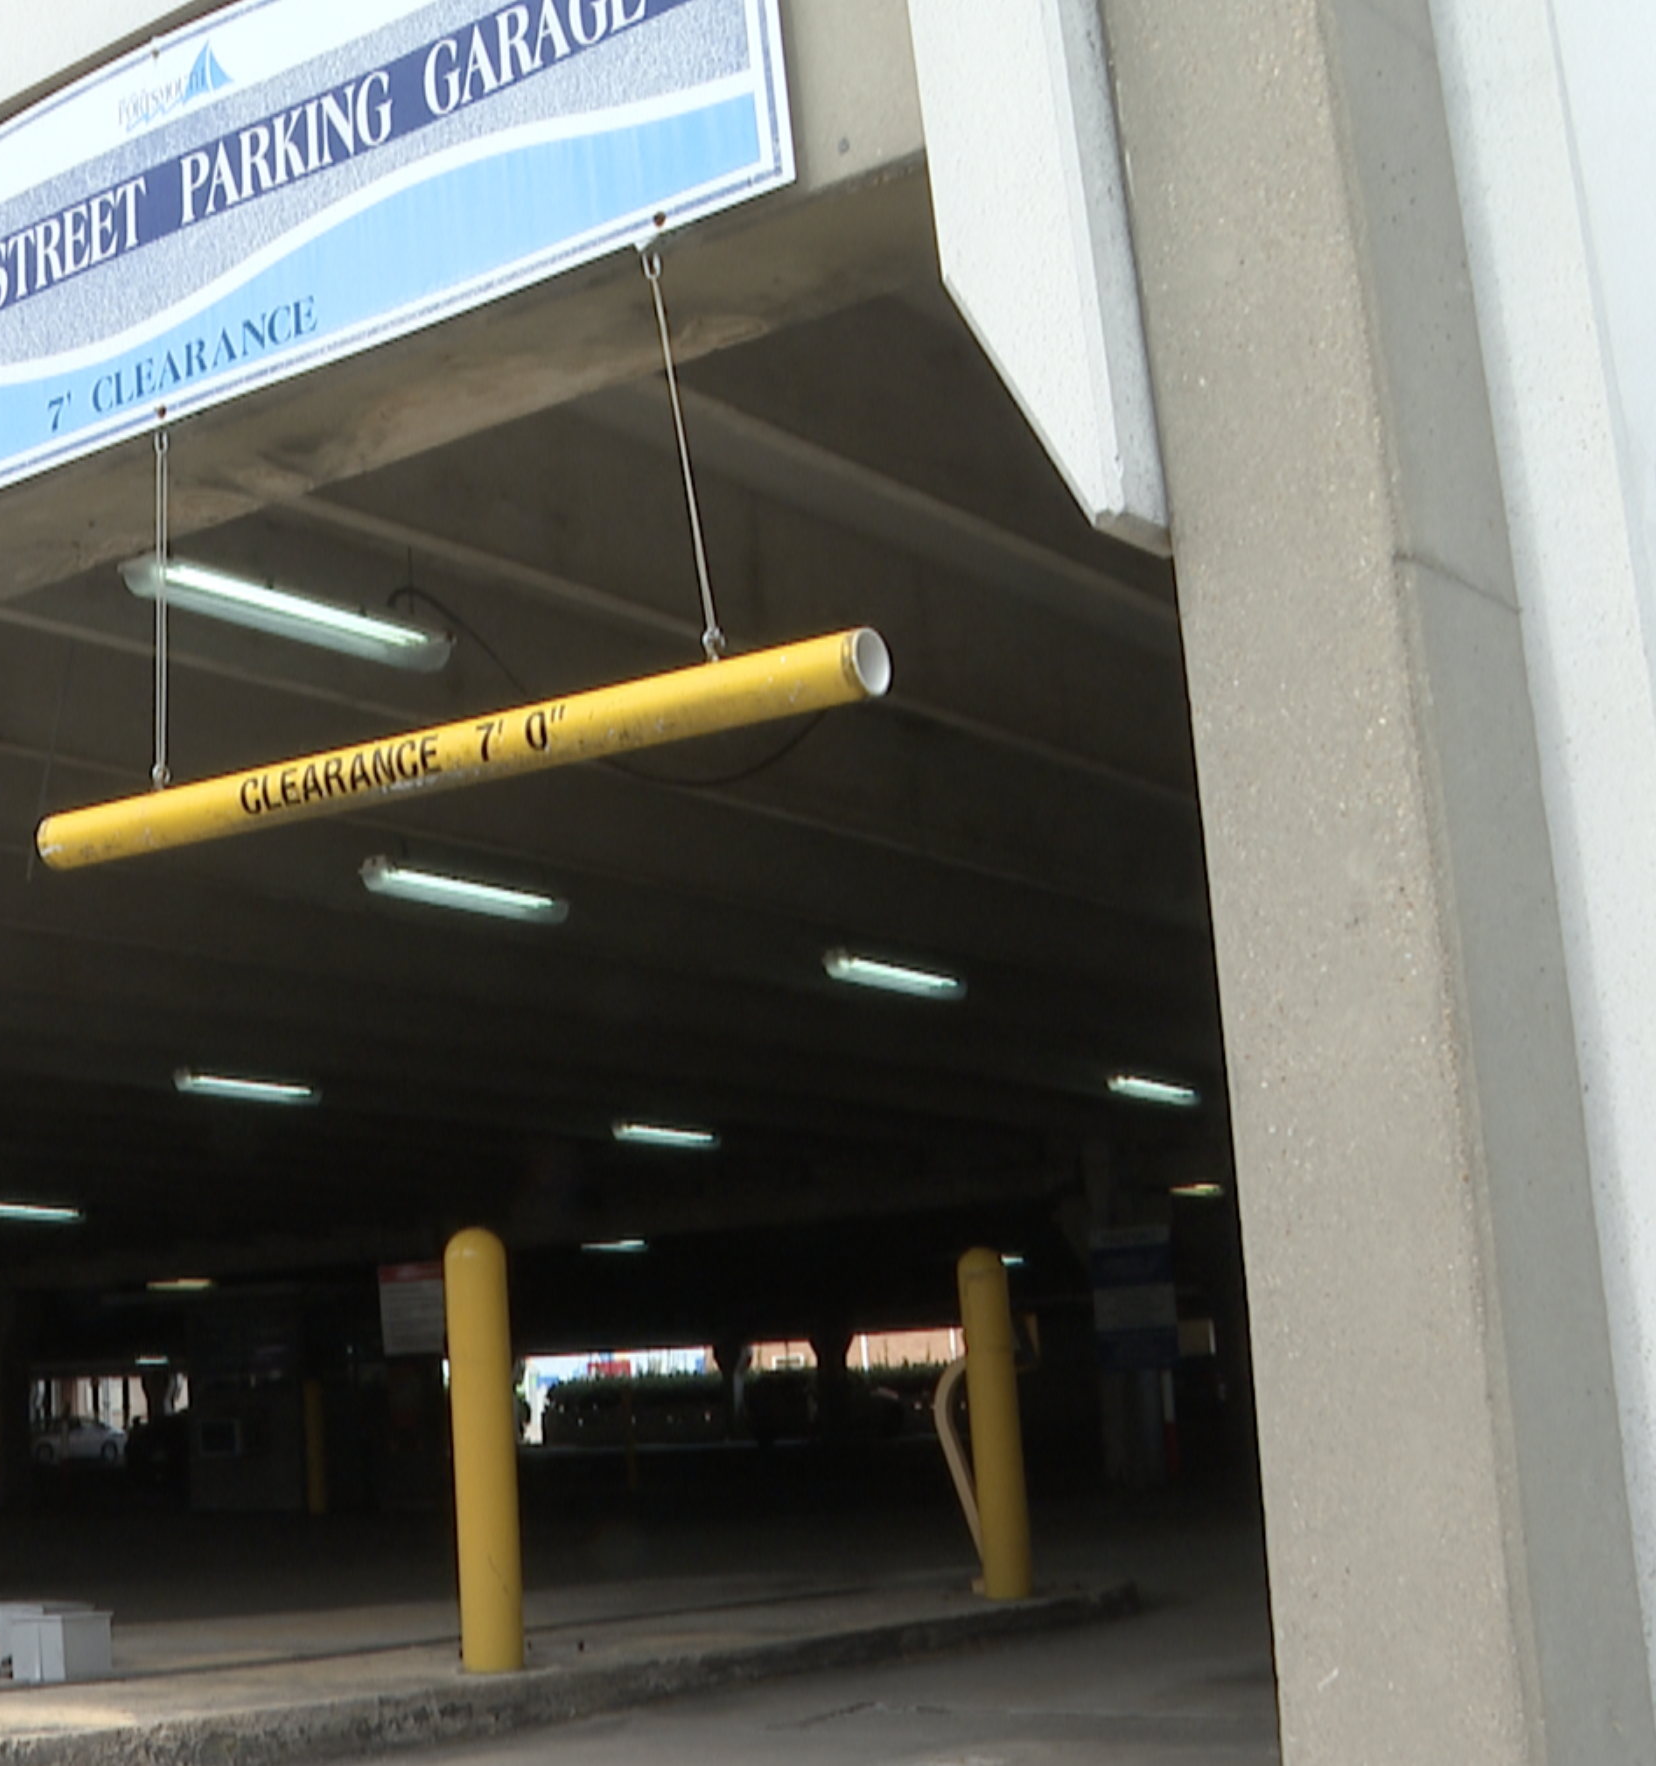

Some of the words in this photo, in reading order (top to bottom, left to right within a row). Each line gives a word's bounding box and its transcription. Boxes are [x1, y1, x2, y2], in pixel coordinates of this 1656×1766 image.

[179, 70, 393, 222] PARKING
[47, 392, 74, 433] 7'
[91, 296, 319, 414] CLEARANCE
[239, 736, 442, 815] CLEARANCE
[474, 719, 505, 763] 7'
